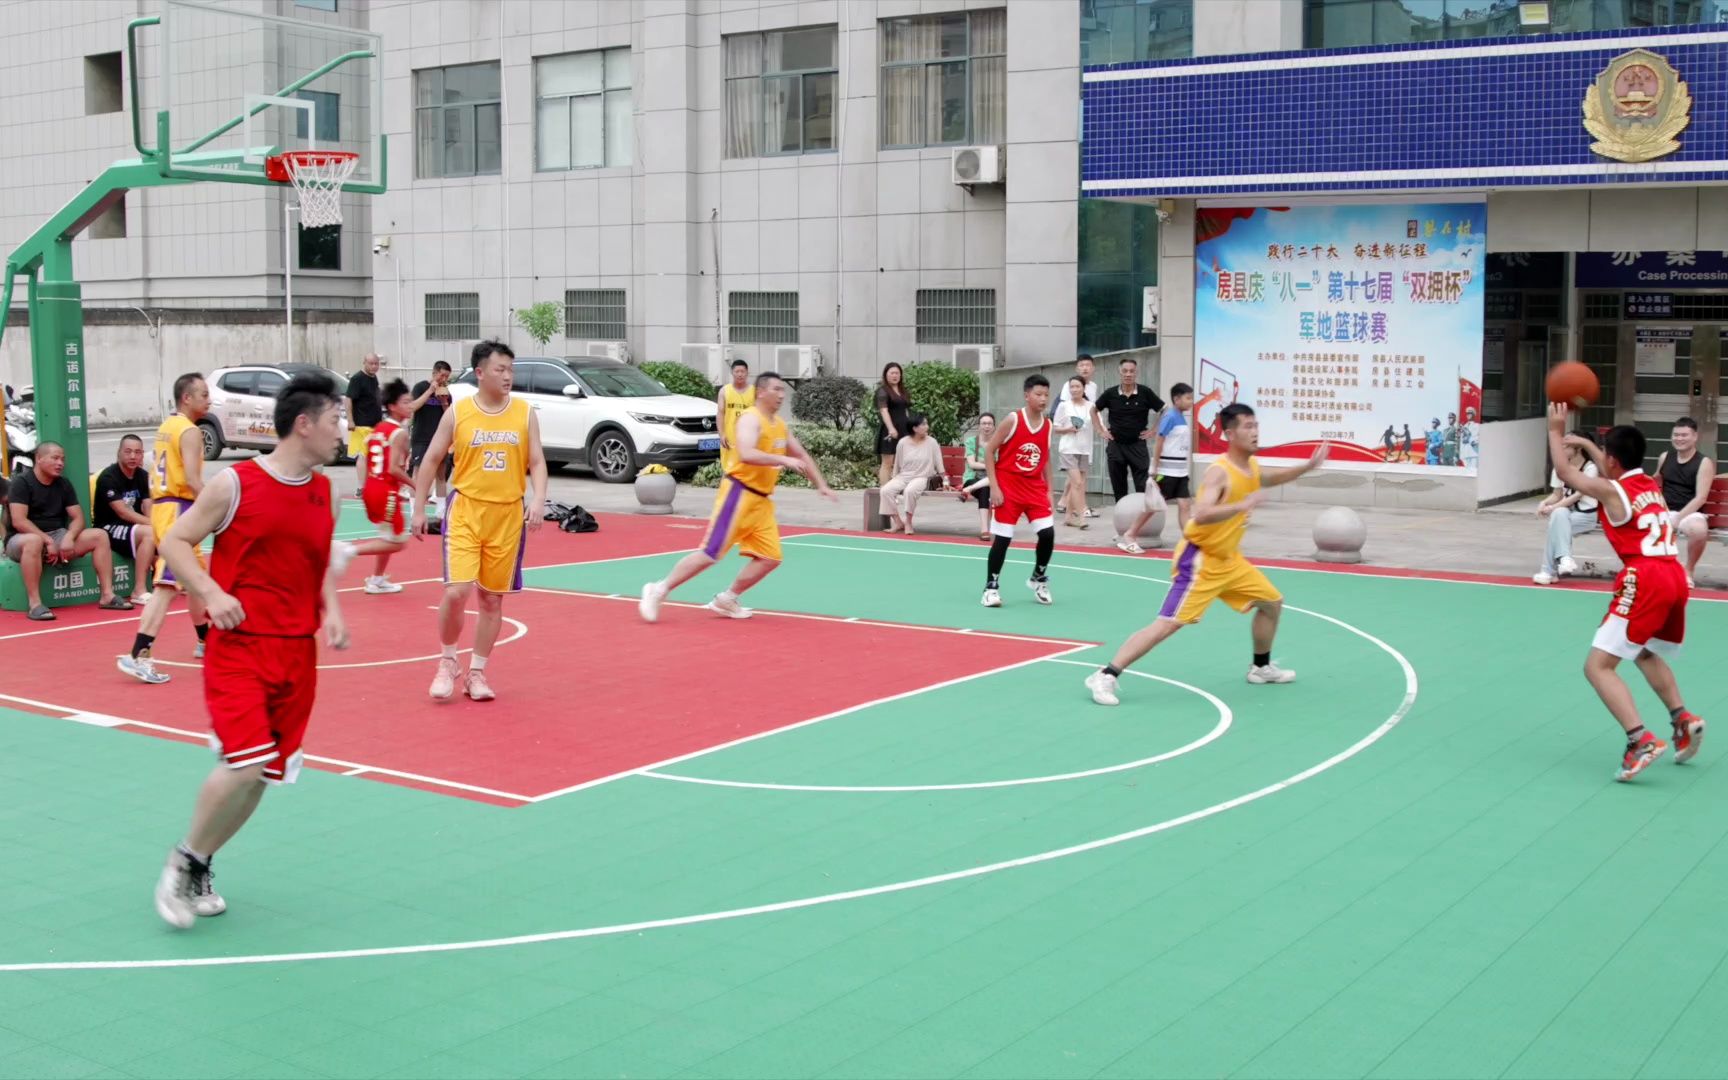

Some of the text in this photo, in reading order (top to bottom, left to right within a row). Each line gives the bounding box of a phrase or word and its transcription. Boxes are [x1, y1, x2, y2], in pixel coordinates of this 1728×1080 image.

[1267, 243, 1428, 260] 践行二十大 奋进新征程
[1638, 270, 1667, 280] Case
[1299, 312, 1388, 343] 军地篮球赛
[66, 342, 82, 429] 吉诺尔体育
[470, 429, 519, 447] LAKERS
[483, 451, 506, 471] 25
[54, 571, 84, 590] 中国
[53, 588, 100, 600] SHANDONG
